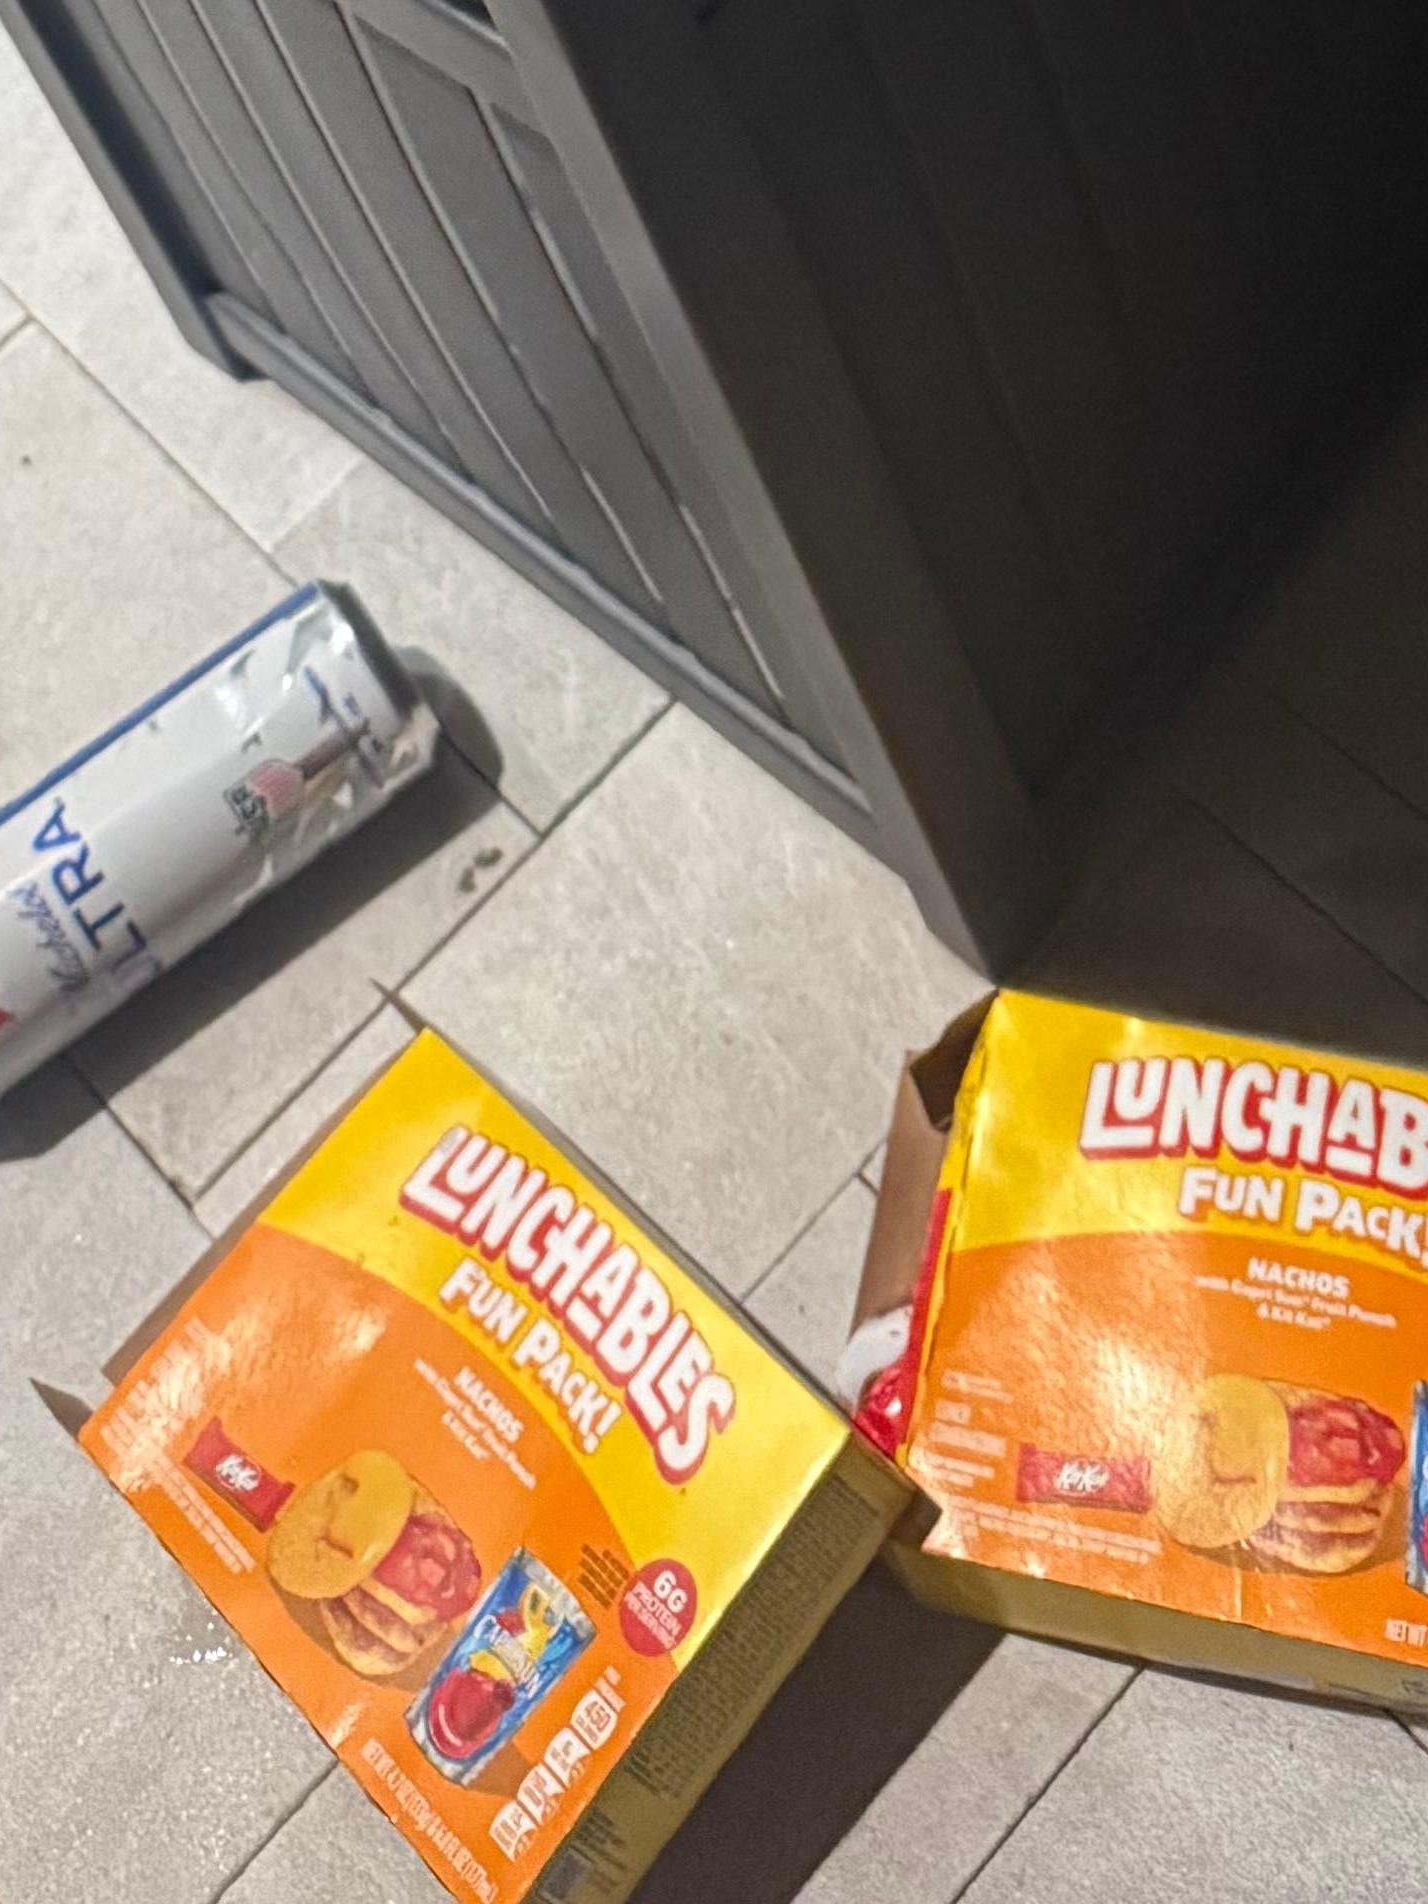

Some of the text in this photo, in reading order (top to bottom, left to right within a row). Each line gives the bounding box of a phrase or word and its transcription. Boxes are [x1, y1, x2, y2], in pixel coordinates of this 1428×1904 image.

[1178, 1166, 1284, 1225] FUN
[398, 1123, 736, 1486] LUNCHABLES
[1248, 1256, 1350, 1299] NACHOS
[437, 1256, 623, 1456] FUN PACK!
[454, 1366, 526, 1445] NACHOS
[630, 1580, 683, 1636] PROTEIN
[647, 1567, 695, 1616] 6G
